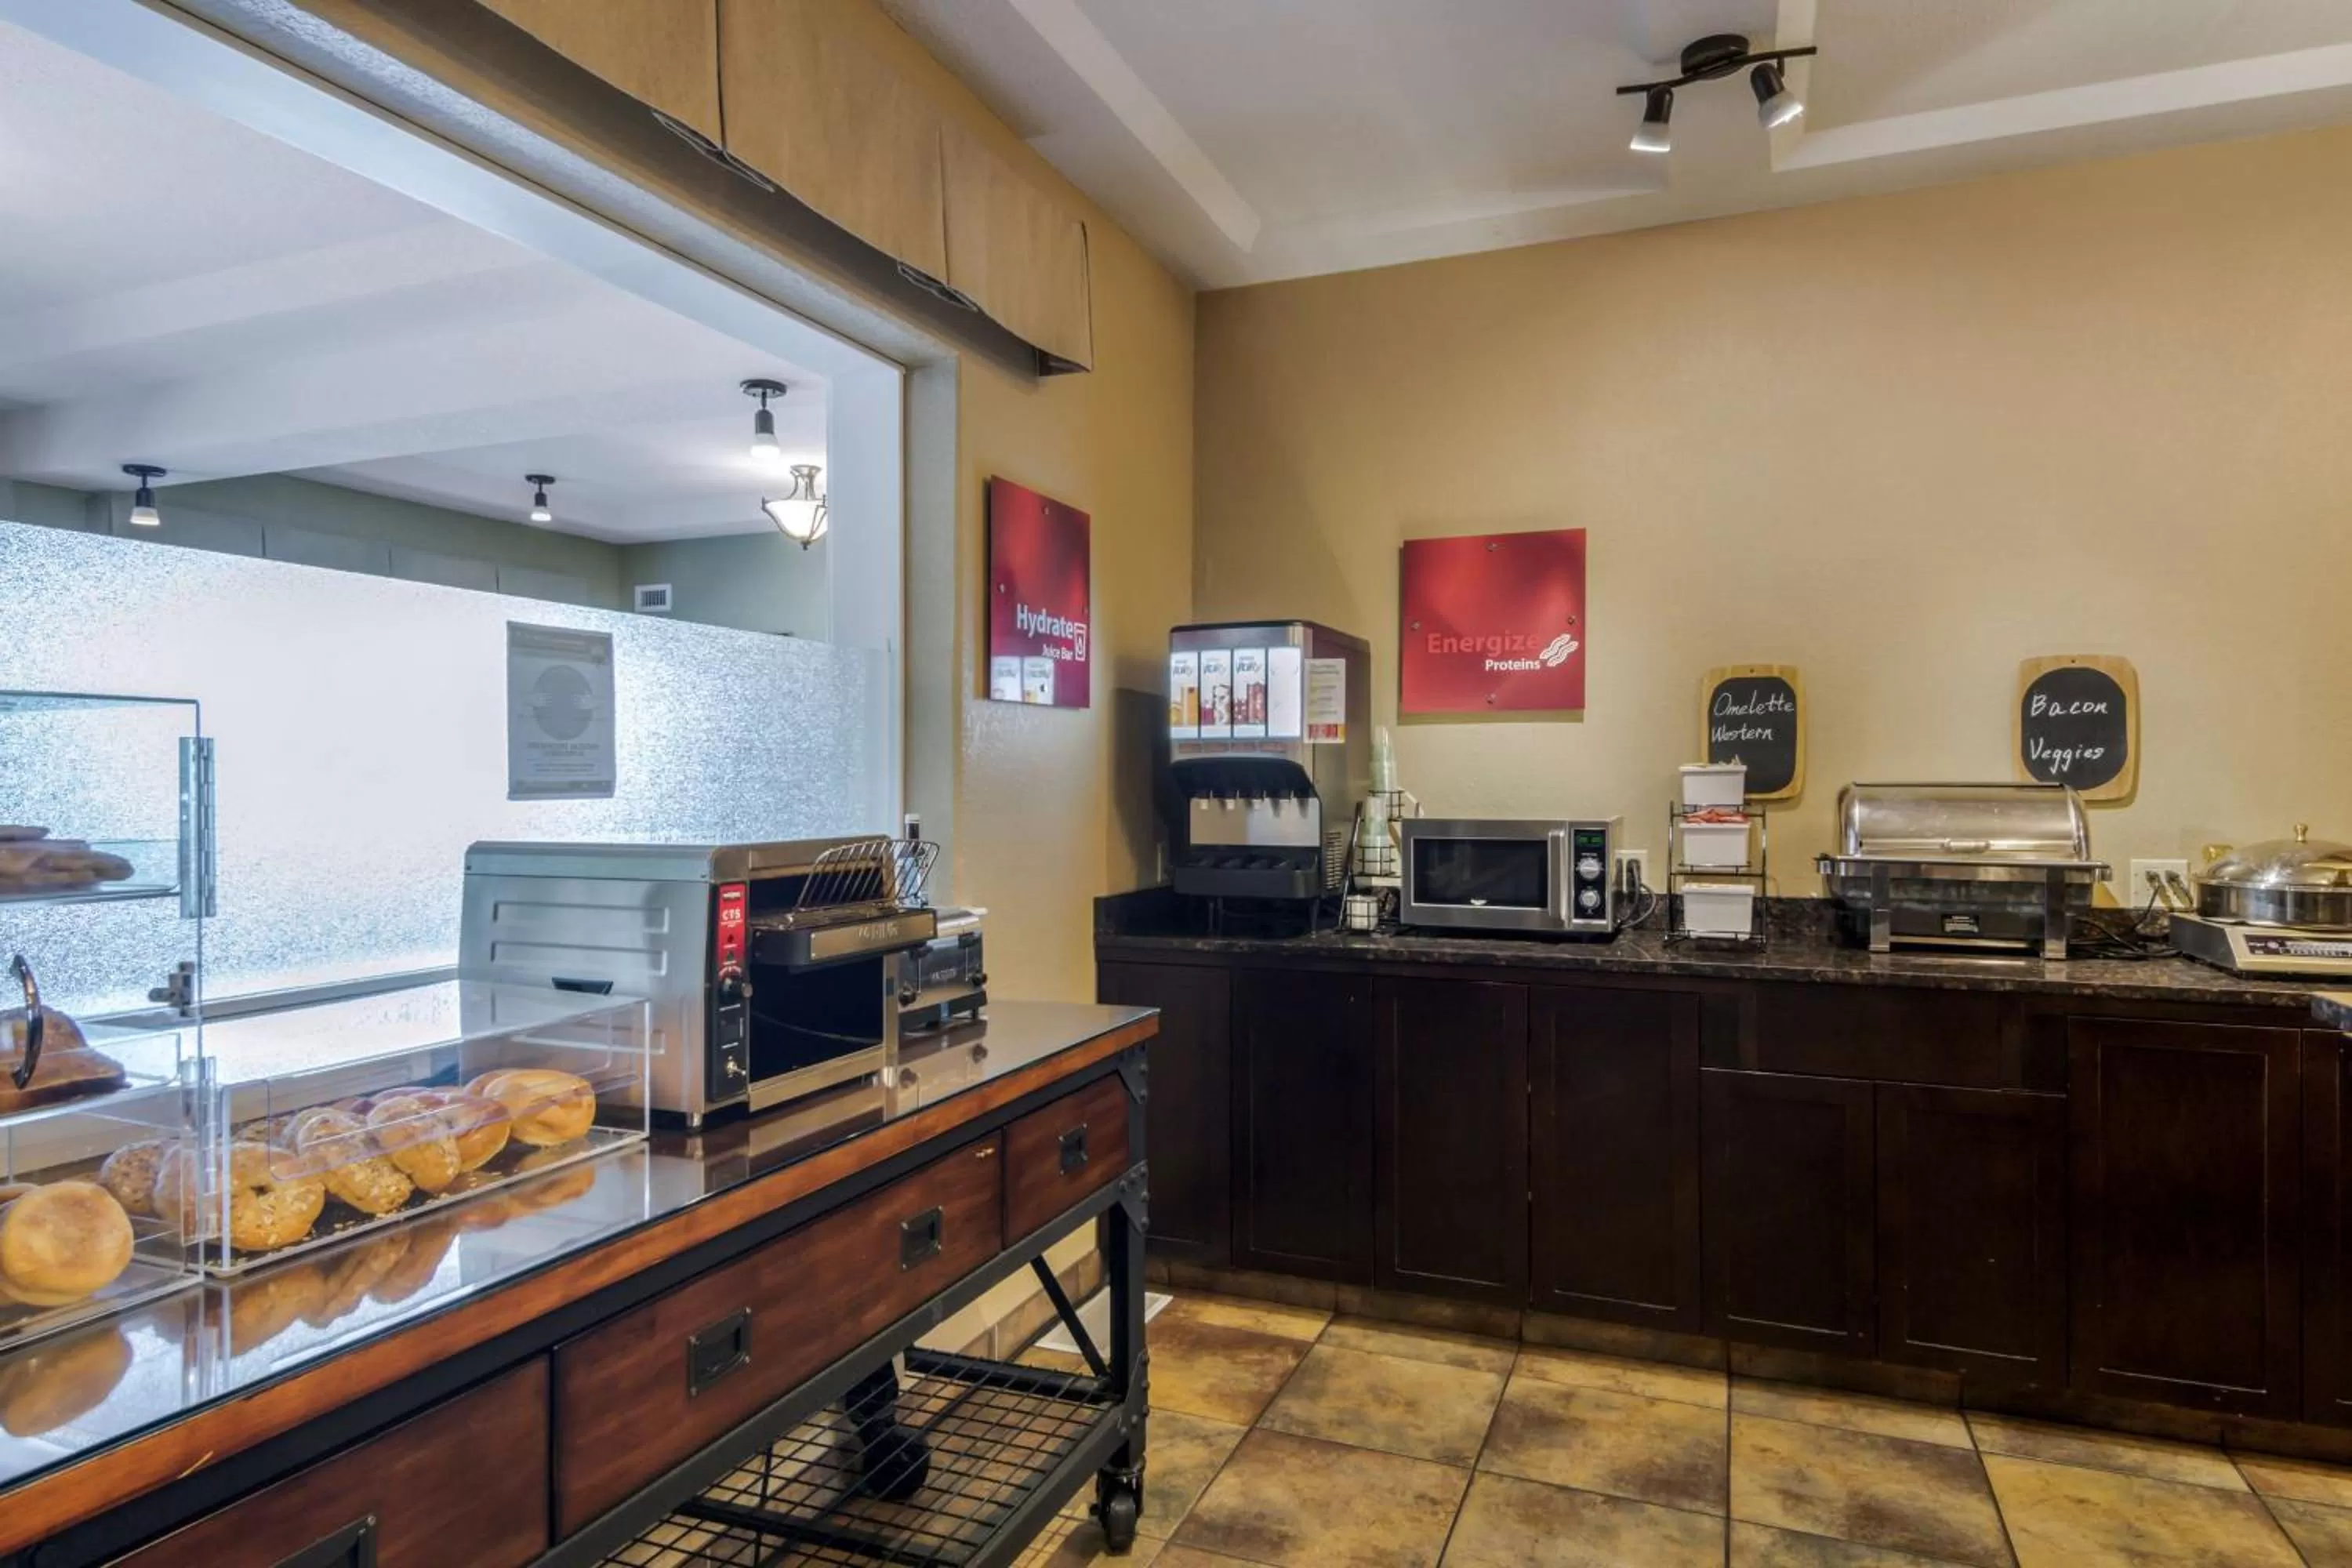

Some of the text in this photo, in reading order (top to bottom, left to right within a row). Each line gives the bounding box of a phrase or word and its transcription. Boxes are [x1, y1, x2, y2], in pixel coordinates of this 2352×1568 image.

[1017, 603, 1073, 639] Hydrate
[1428, 630, 1540, 657] Energize
[1486, 659, 1541, 671] Proteins
[1713, 689, 1795, 717] Omelette
[2030, 694, 2107, 717] Bacon
[1711, 724, 1773, 743] Western
[2030, 737, 2104, 775] Veggies
